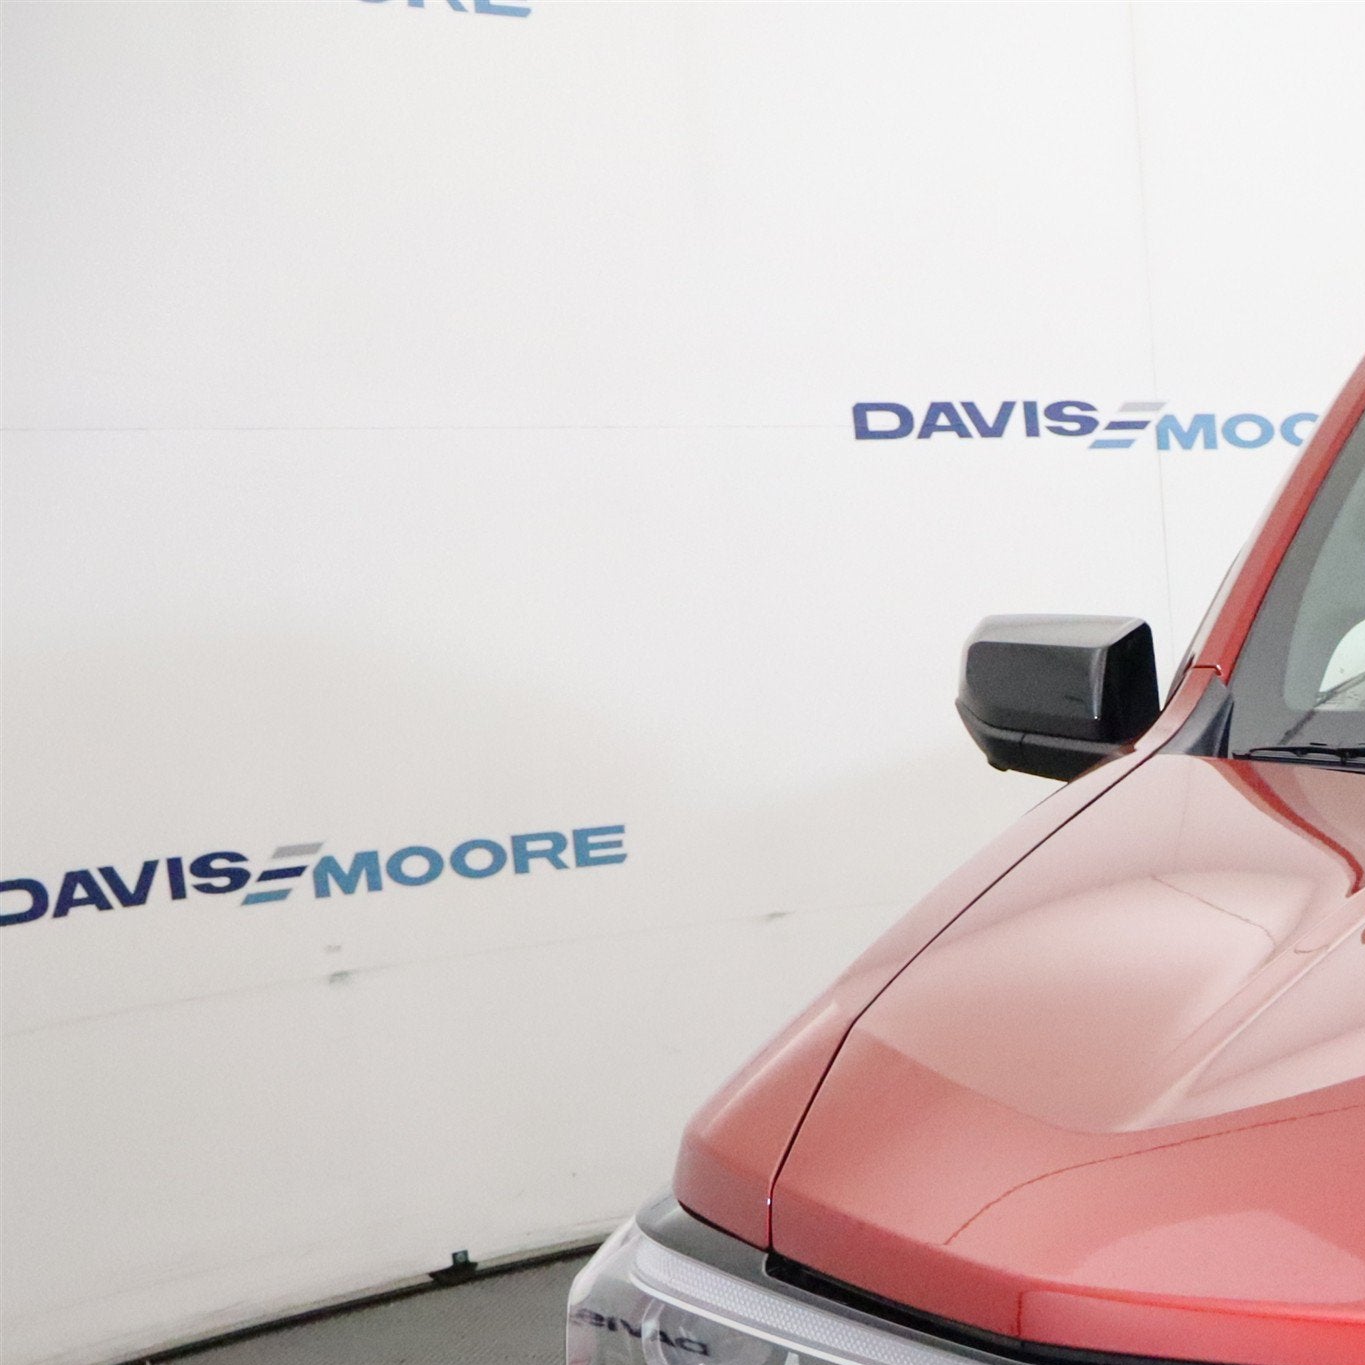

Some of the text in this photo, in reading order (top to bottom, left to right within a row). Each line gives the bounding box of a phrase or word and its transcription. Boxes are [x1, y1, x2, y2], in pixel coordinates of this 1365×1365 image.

[851, 399, 1321, 452] DAVIS MOO
[0, 824, 628, 928] DAVIS MOORE
